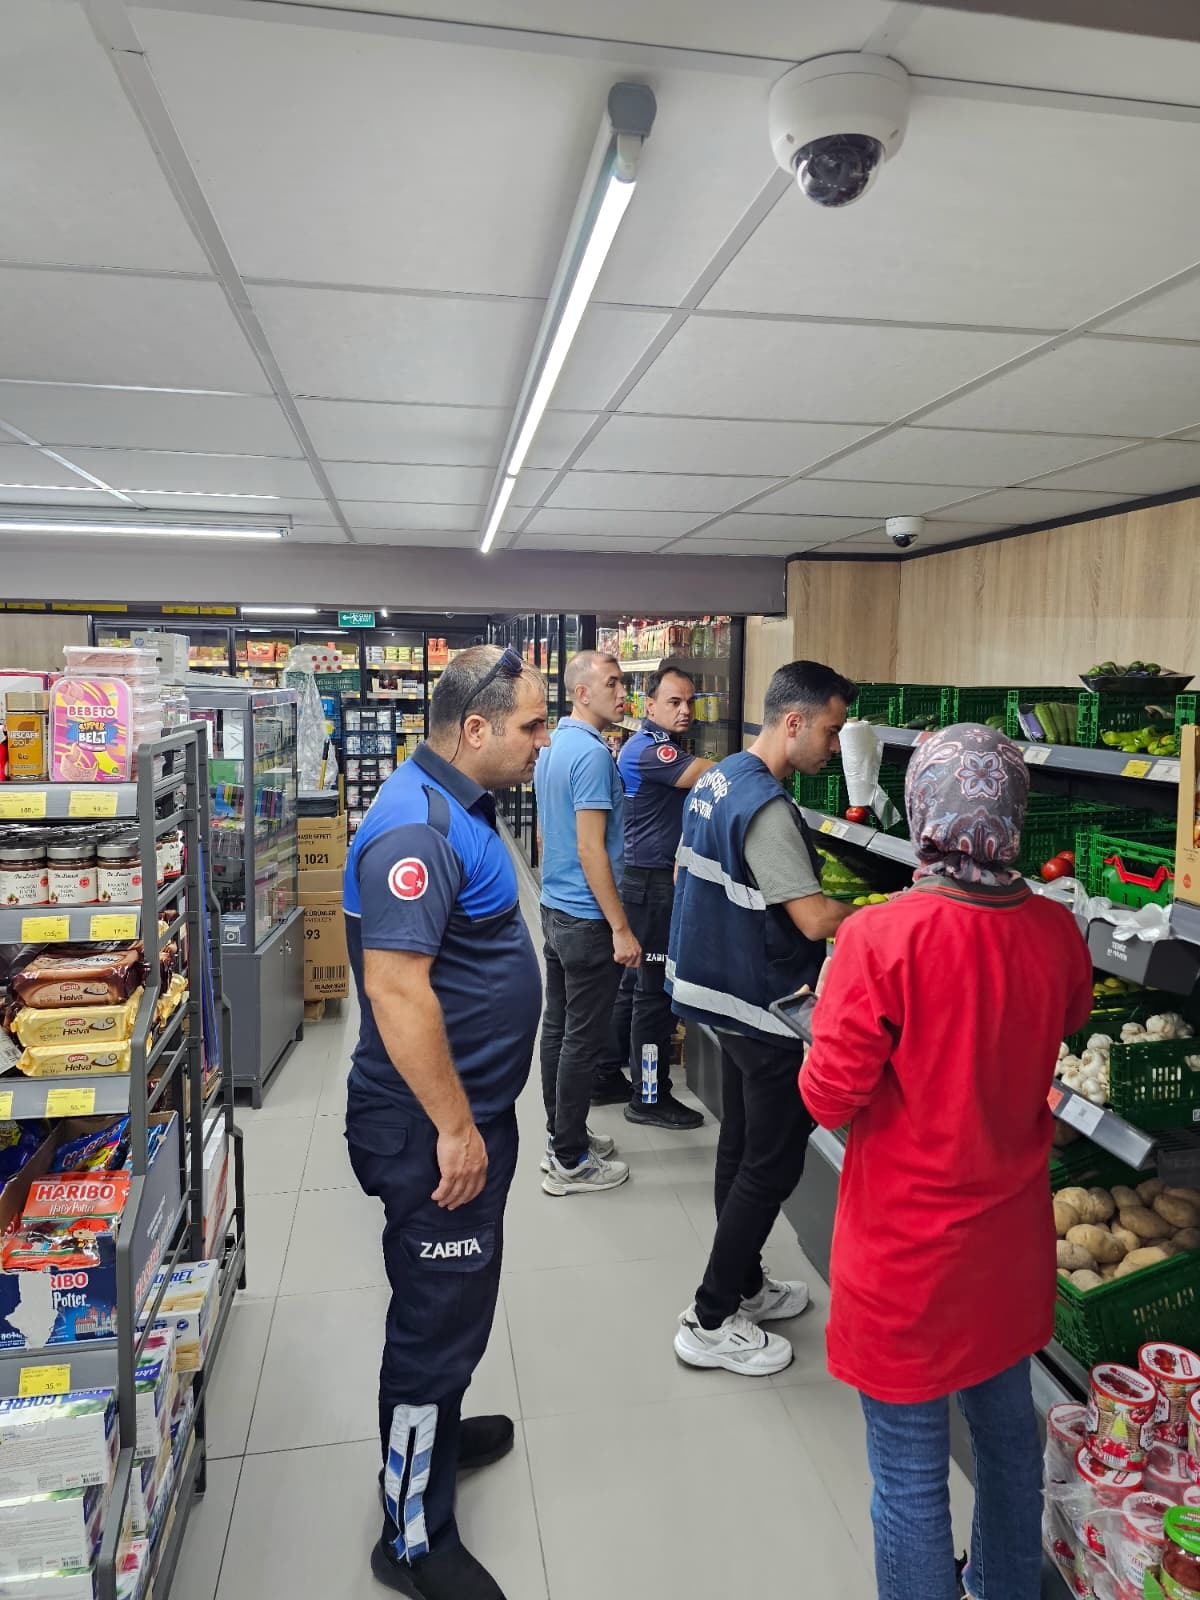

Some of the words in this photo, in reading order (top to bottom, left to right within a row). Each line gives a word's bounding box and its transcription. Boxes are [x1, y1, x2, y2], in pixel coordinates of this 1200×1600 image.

[68, 705, 116, 717] BEBETO
[78, 731, 107, 744] BELT
[305, 854, 329, 865] 1021
[304, 929, 320, 940] 93
[62, 1028, 90, 1036] Helva
[65, 1063, 92, 1072] Helva
[36, 1184, 115, 1201] HARIBO
[420, 1237, 482, 1259] ZABITA
[51, 1272, 88, 1289] RIBO
[53, 1291, 87, 1308] Potter
